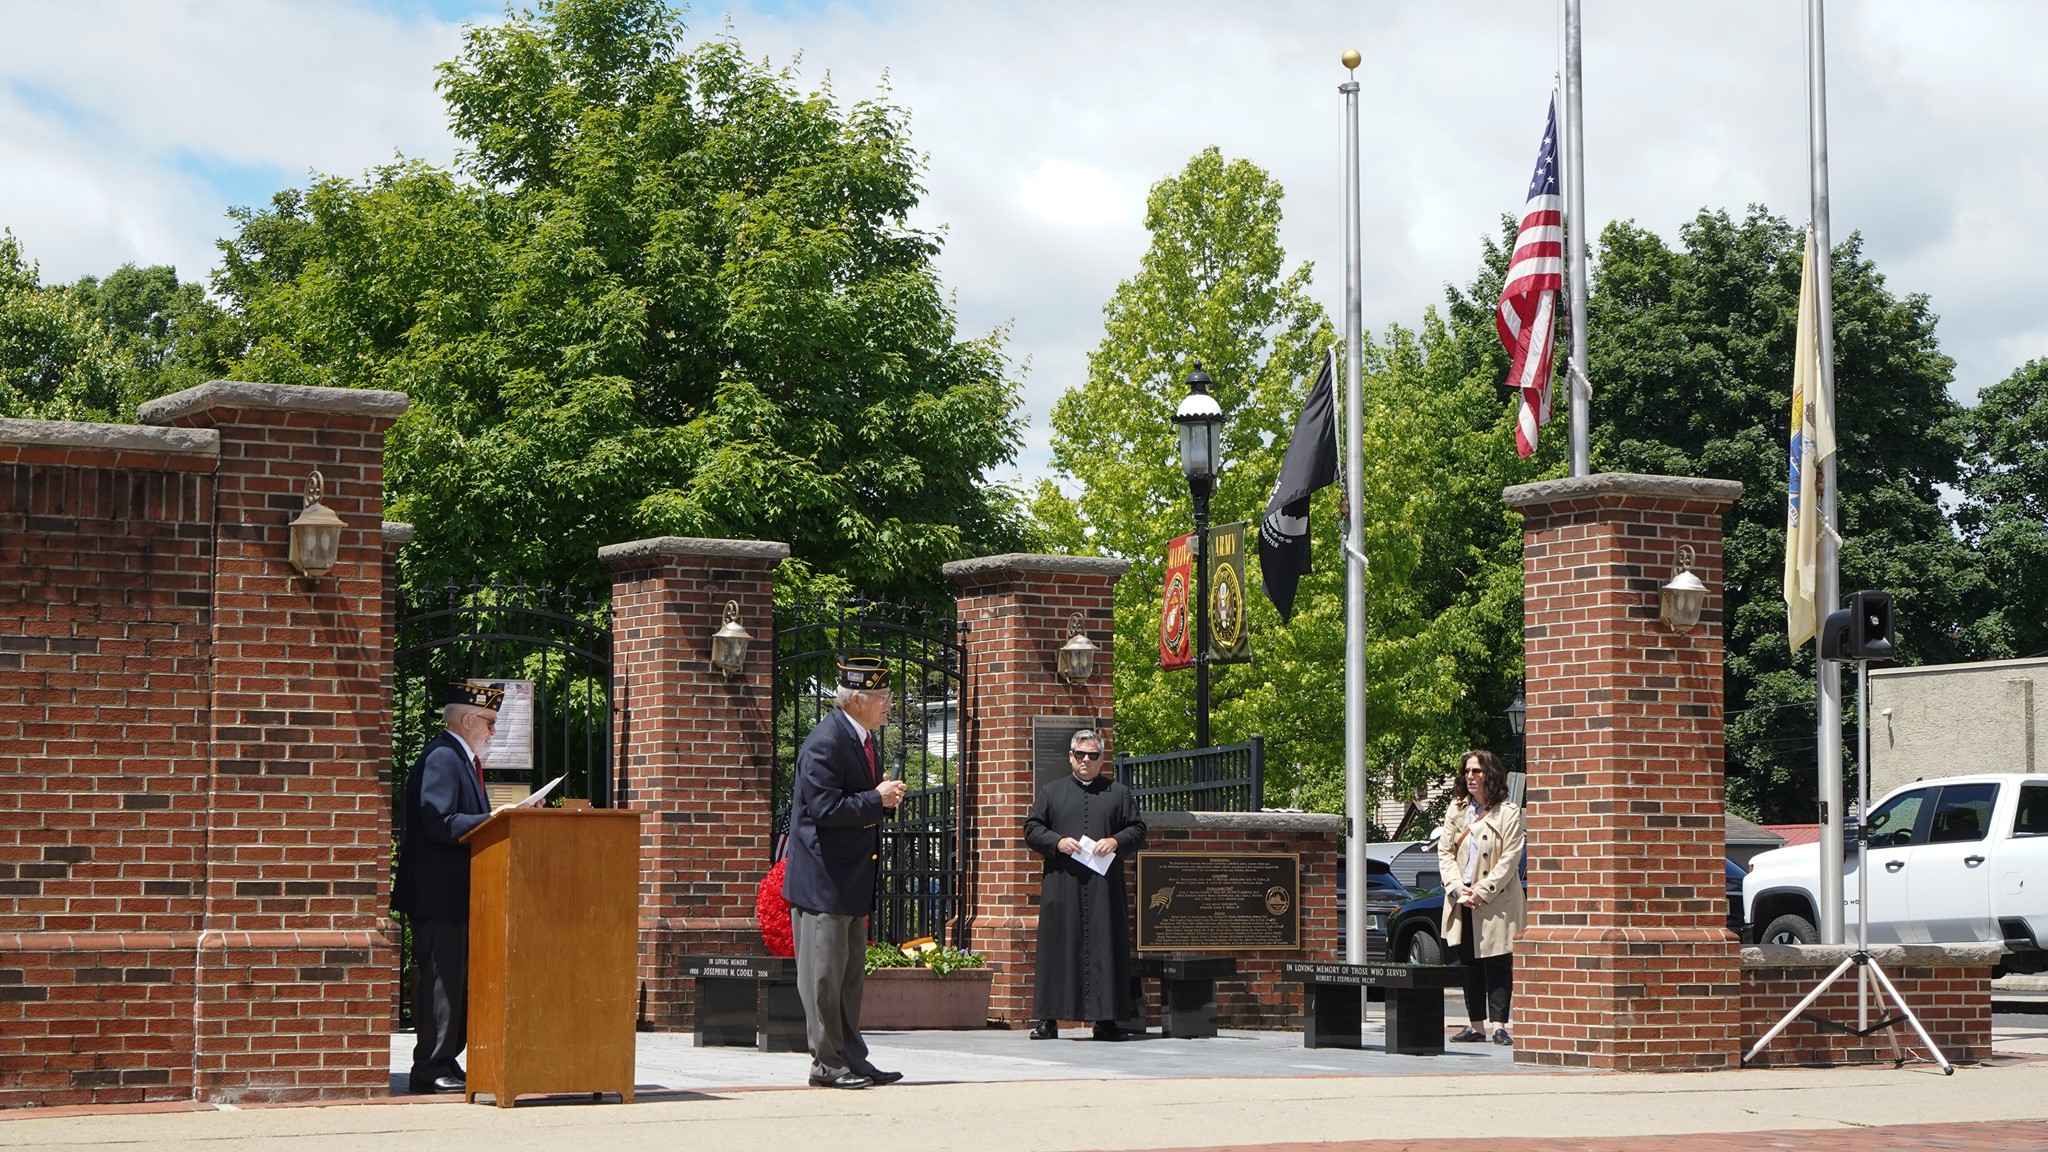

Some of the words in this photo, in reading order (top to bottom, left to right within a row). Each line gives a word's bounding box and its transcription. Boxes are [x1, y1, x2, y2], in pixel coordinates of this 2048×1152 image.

[1215, 533, 1237, 557] ARMY
[703, 967, 728, 976] JOSEPHINE
[736, 969, 753, 977] COOKE
[1286, 963, 1293, 971] IN
[1294, 964, 1314, 973] LOVING
[1316, 965, 1340, 974] MEMORY
[1341, 966, 1349, 974] OF
[1351, 967, 1368, 976] THOSE
[1370, 968, 1384, 976] WHO
[1386, 968, 1407, 977] SERVED
[1315, 974, 1332, 982] ROBERT
[1337, 976, 1360, 984] STEPHANIE
